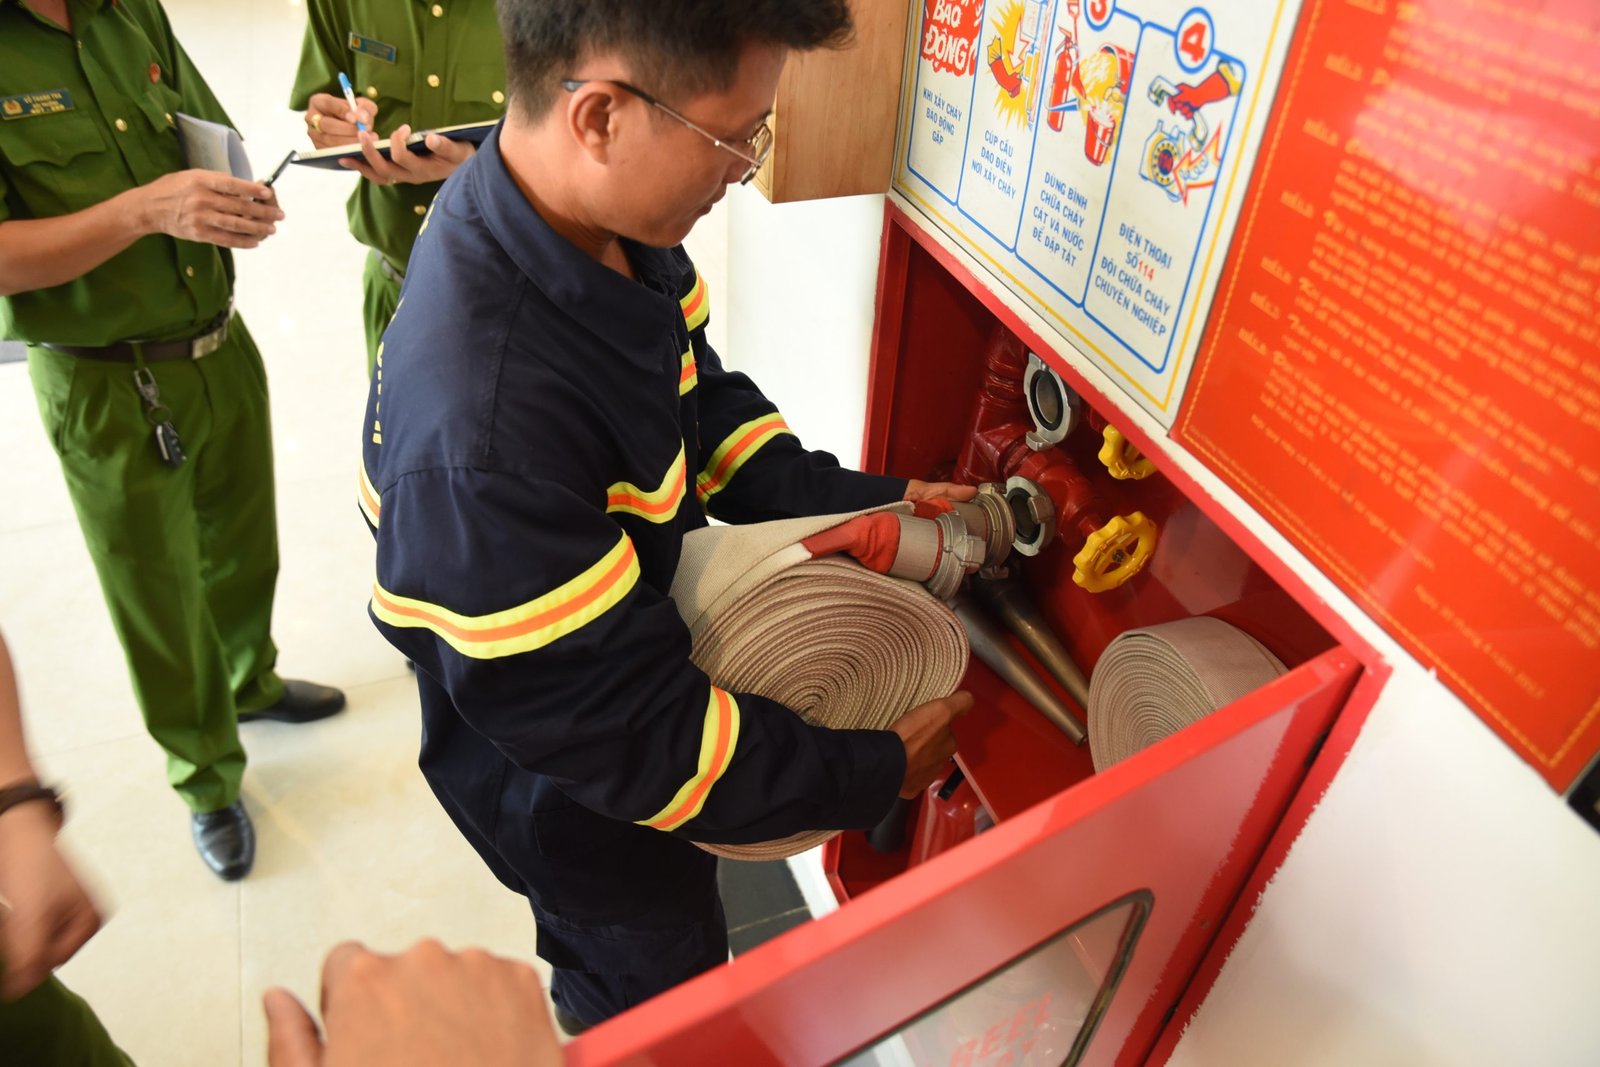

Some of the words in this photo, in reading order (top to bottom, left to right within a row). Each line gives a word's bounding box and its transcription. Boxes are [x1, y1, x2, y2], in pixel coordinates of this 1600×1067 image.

[1180, 22, 1206, 63] 4
[981, 147, 995, 164] DAO
[1040, 190, 1061, 212] CHỮA
[1062, 206, 1085, 228] CHÁY
[1044, 172, 1066, 195] DÙNG
[1067, 187, 1088, 210] BÌNH
[1033, 206, 1048, 224] CÁT
[1050, 217, 1060, 233] VÀ
[1061, 227, 1085, 251] NƯỚC
[1044, 235, 1061, 255] DẬP
[1119, 222, 1142, 248] ĐIỆN
[1143, 239, 1173, 270] THOẠI
[1100, 256, 1117, 277] ĐỘI
[1117, 270, 1143, 296] CHỮA
[1144, 289, 1171, 316] CHÁY
[1137, 260, 1154, 282] 114
[1094, 275, 1131, 310] CHUYÊN
[1131, 303, 1166, 336] NGHIỆP
